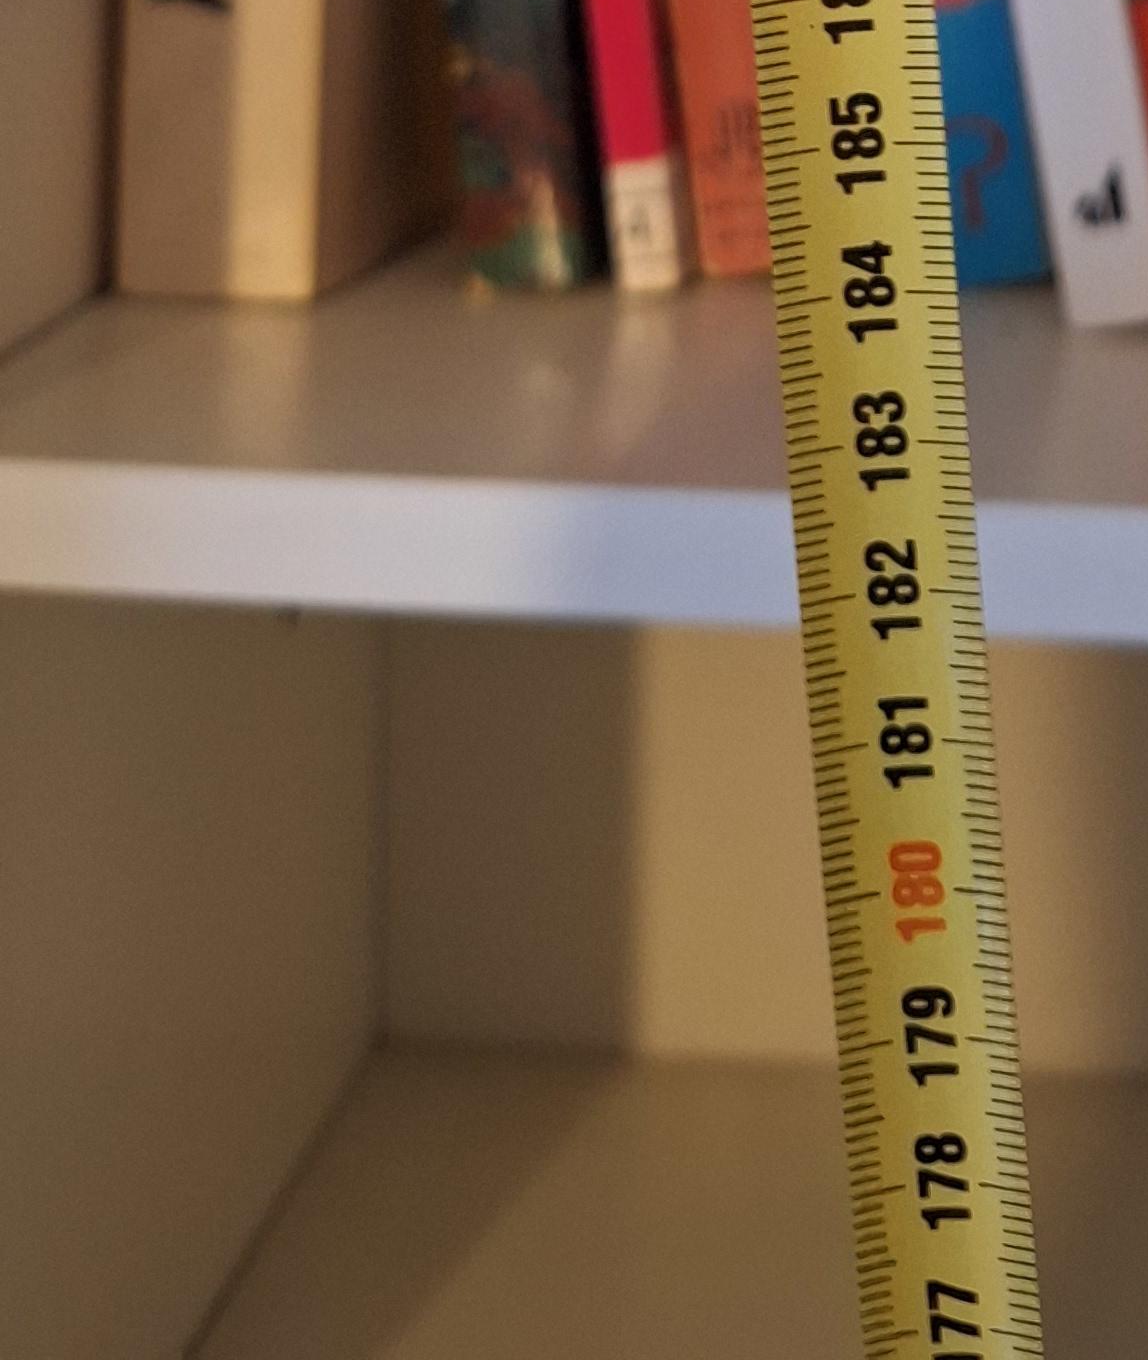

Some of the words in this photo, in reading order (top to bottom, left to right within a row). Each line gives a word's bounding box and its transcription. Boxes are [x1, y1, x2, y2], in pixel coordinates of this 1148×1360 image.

[829, 93, 886, 195] 185
[841, 240, 898, 343] 184
[852, 391, 910, 492] 183
[863, 539, 922, 640] 182
[877, 697, 934, 789] 181
[888, 842, 945, 942] 180
[901, 986, 959, 1088] 179
[914, 1133, 971, 1230] 178
